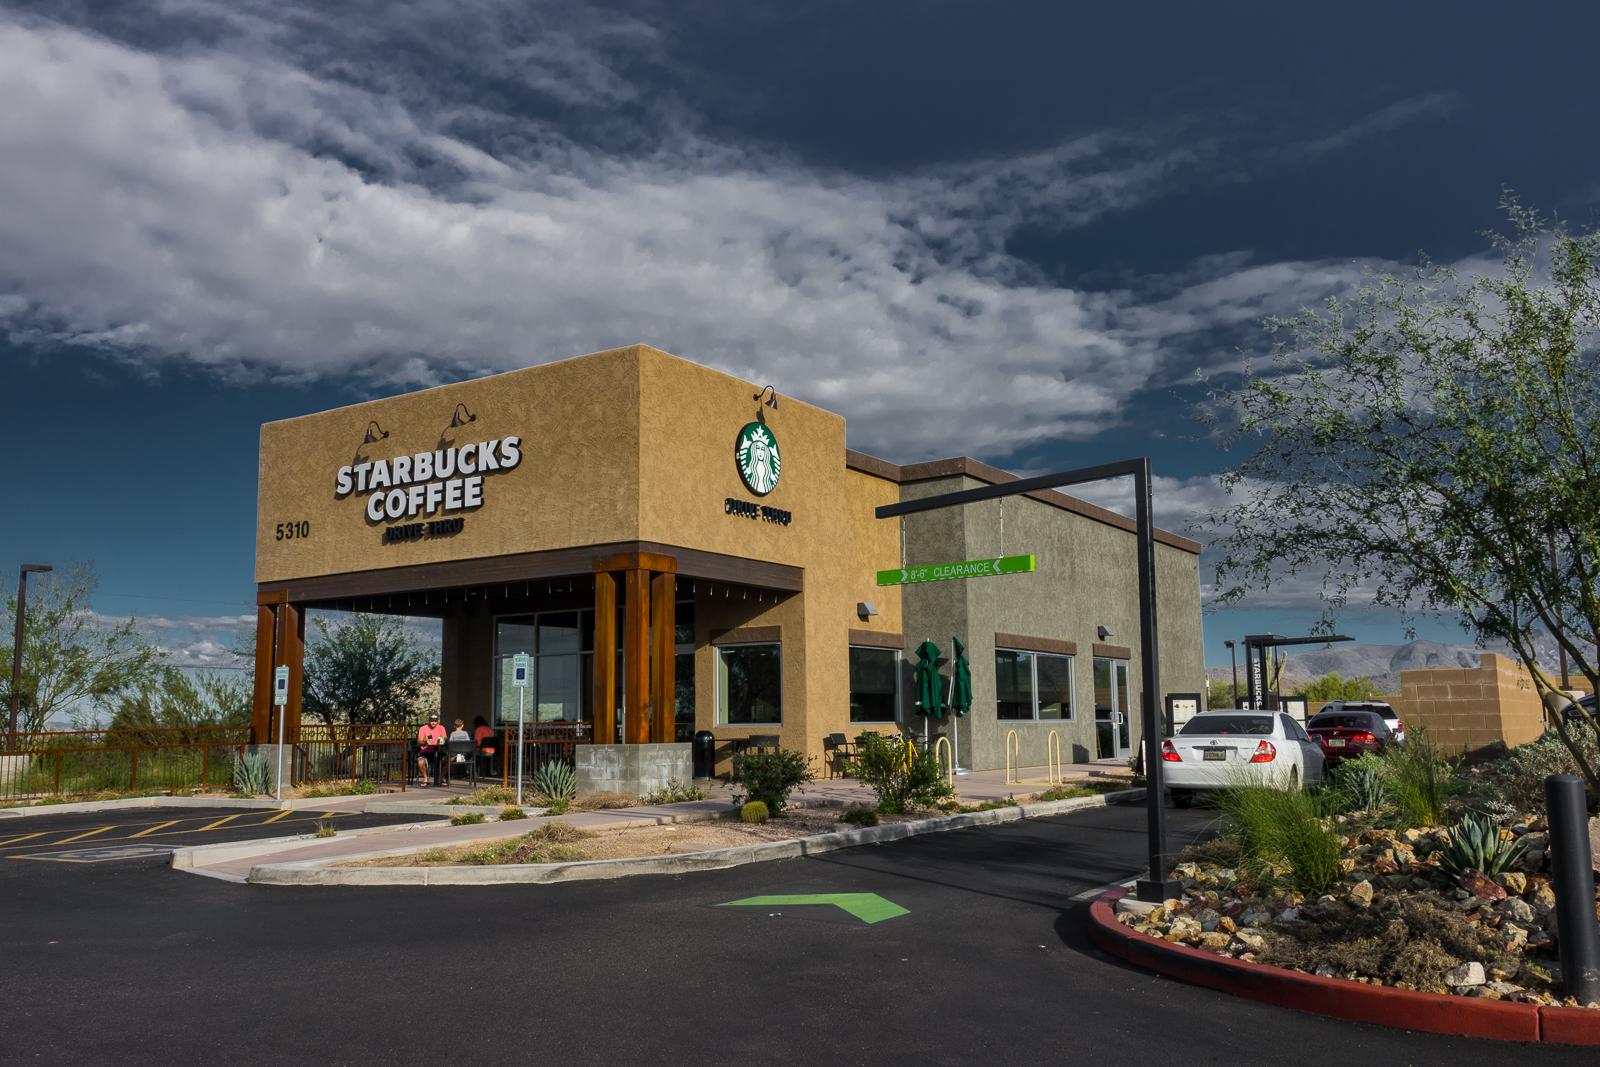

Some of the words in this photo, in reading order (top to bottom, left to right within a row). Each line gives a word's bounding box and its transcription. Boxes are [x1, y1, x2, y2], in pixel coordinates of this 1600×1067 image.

[336, 436, 520, 494] STARBUCKS
[367, 476, 483, 521] COFFEE
[725, 498, 760, 519] DRIVE
[276, 521, 309, 541] 5310
[384, 523, 425, 542] DRIVE
[426, 518, 464, 538] THRU
[933, 562, 990, 577] CLEARANCE
[1253, 658, 1262, 708] STARBUCKS
